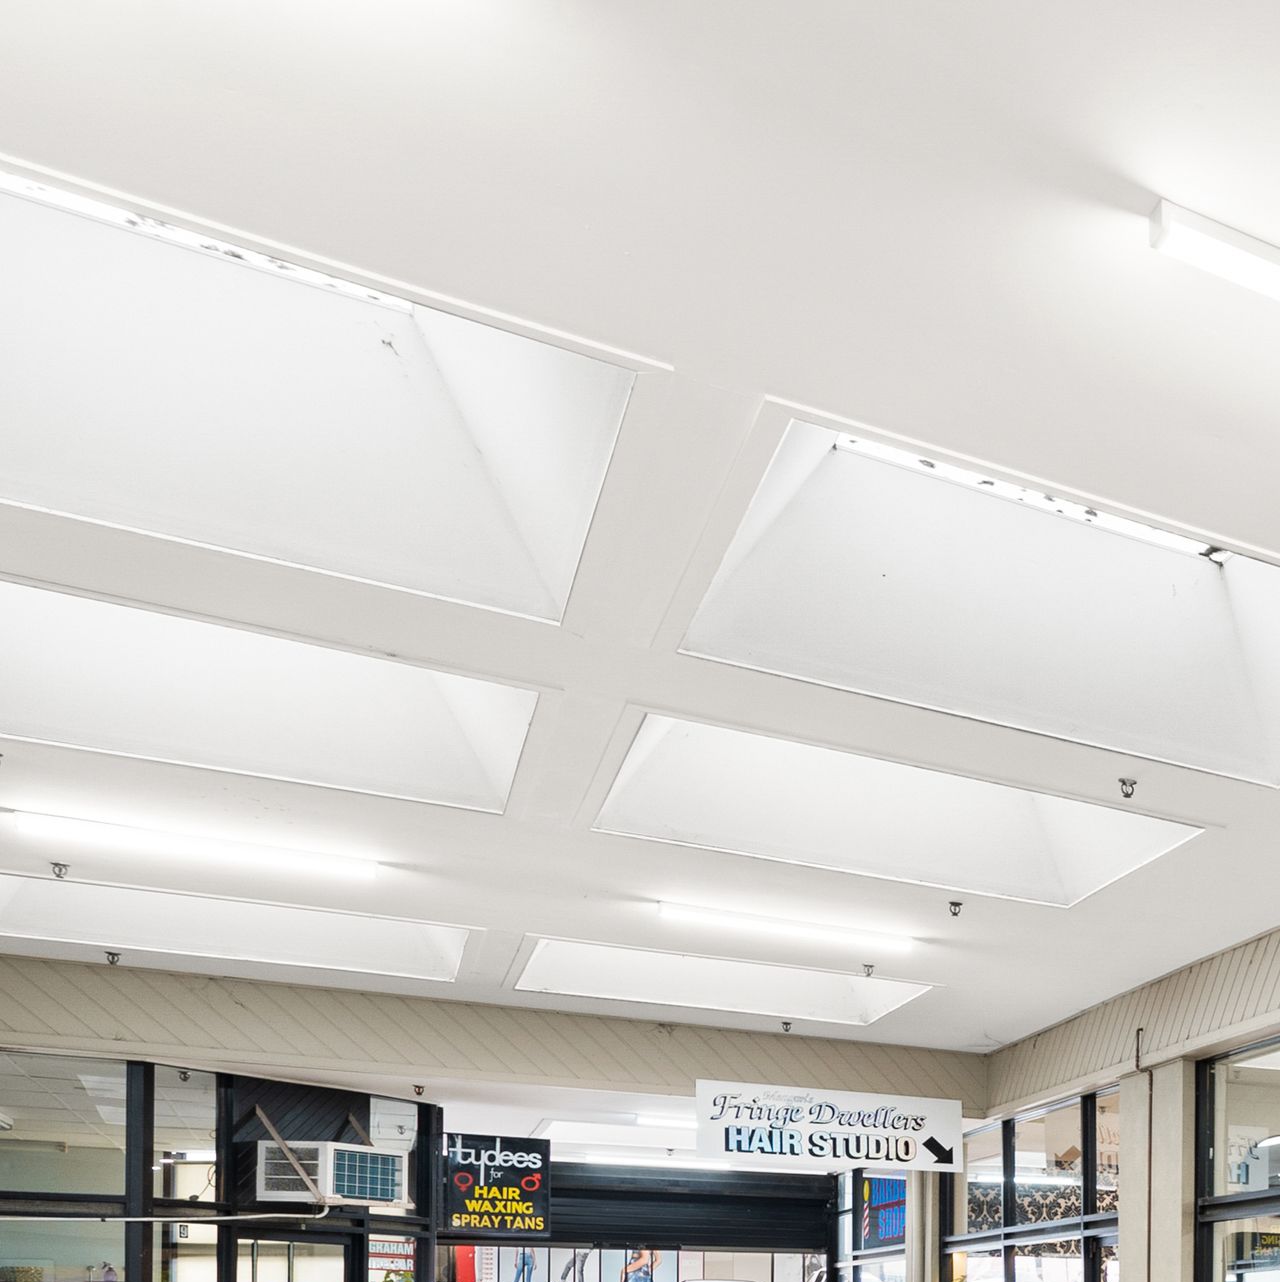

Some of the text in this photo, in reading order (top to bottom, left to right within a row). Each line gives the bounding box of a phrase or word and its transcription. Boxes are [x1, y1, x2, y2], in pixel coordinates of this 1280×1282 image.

[710, 1093, 805, 1129] Fringe
[808, 1101, 928, 1132] Dwellers
[724, 1125, 917, 1162] HAIR STUDIO
[448, 1135, 543, 1187] tydees
[488, 1167, 504, 1183] for
[474, 1185, 521, 1200] HAIR
[871, 1179, 906, 1207] BARBE
[464, 1199, 534, 1215] WAXING
[452, 1213, 545, 1230] SPRAY TANS
